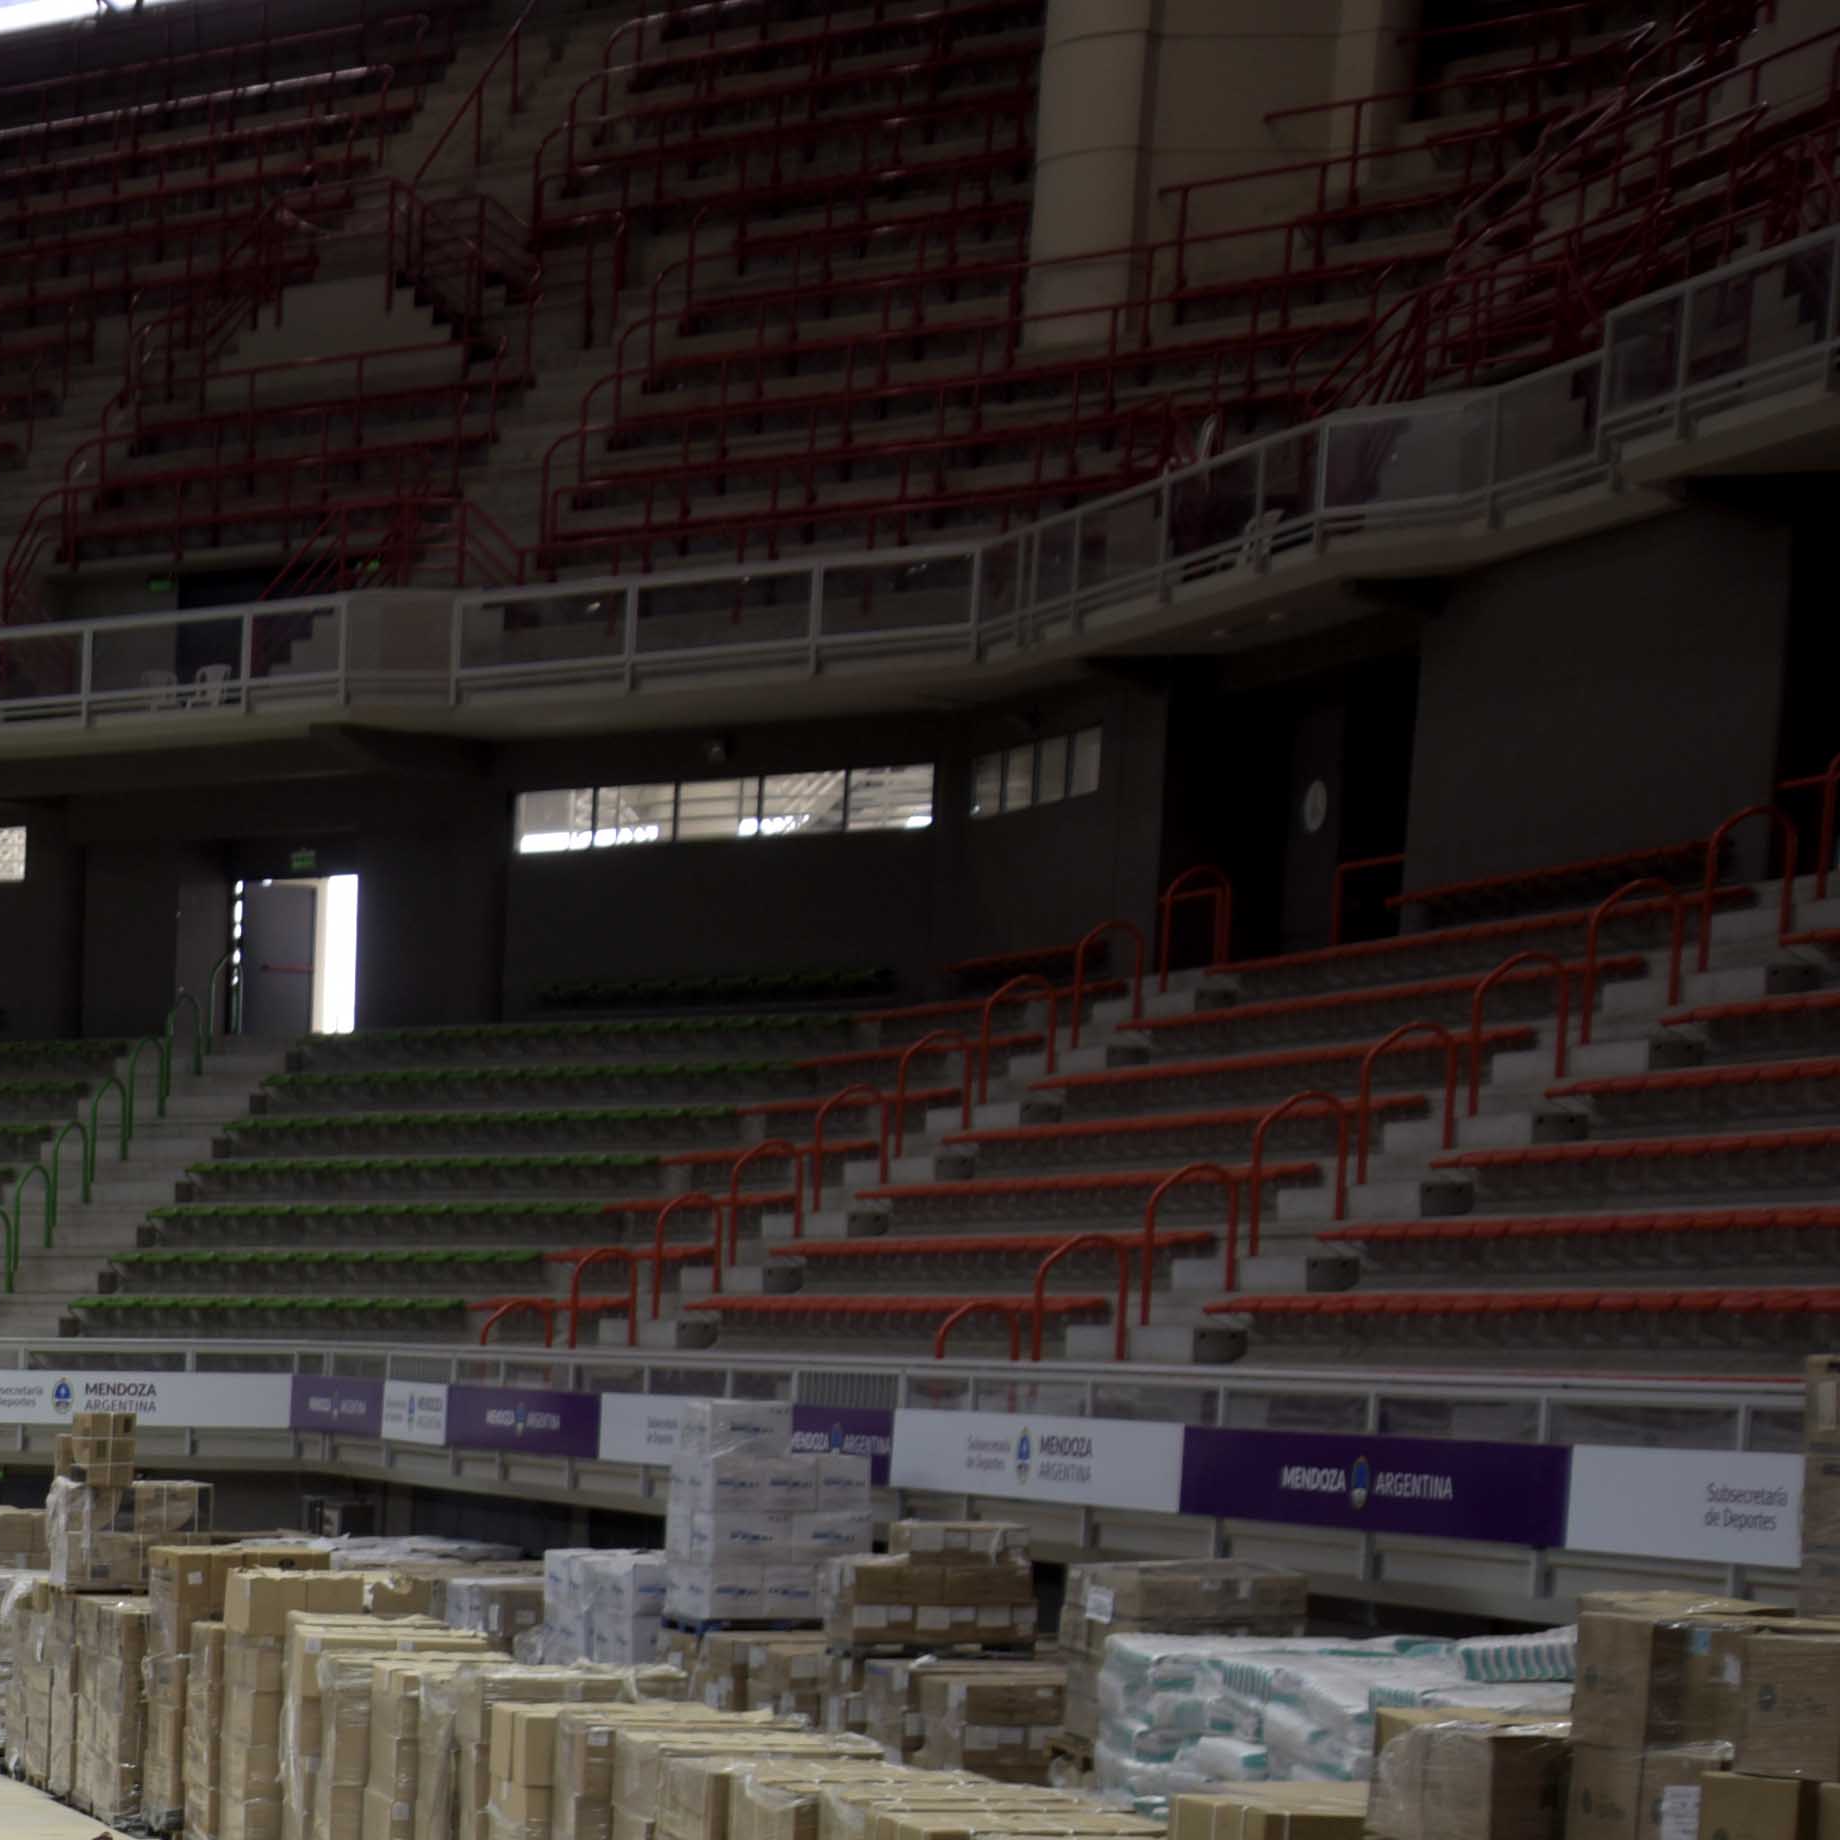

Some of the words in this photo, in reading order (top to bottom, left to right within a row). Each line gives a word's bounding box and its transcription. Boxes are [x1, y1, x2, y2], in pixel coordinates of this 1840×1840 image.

[85, 1382, 157, 1397] MENDOZA
[85, 1398, 157, 1413] ARGENTINA
[1039, 1435, 1092, 1458] MENDOZA
[1038, 1460, 1092, 1483] ARGENTINA
[1280, 1464, 1346, 1493] MENDOZA
[1374, 1471, 1454, 1501] ARGENTINA
[1704, 1507, 1721, 1526] de
[1723, 1507, 1777, 1532] Deportes
